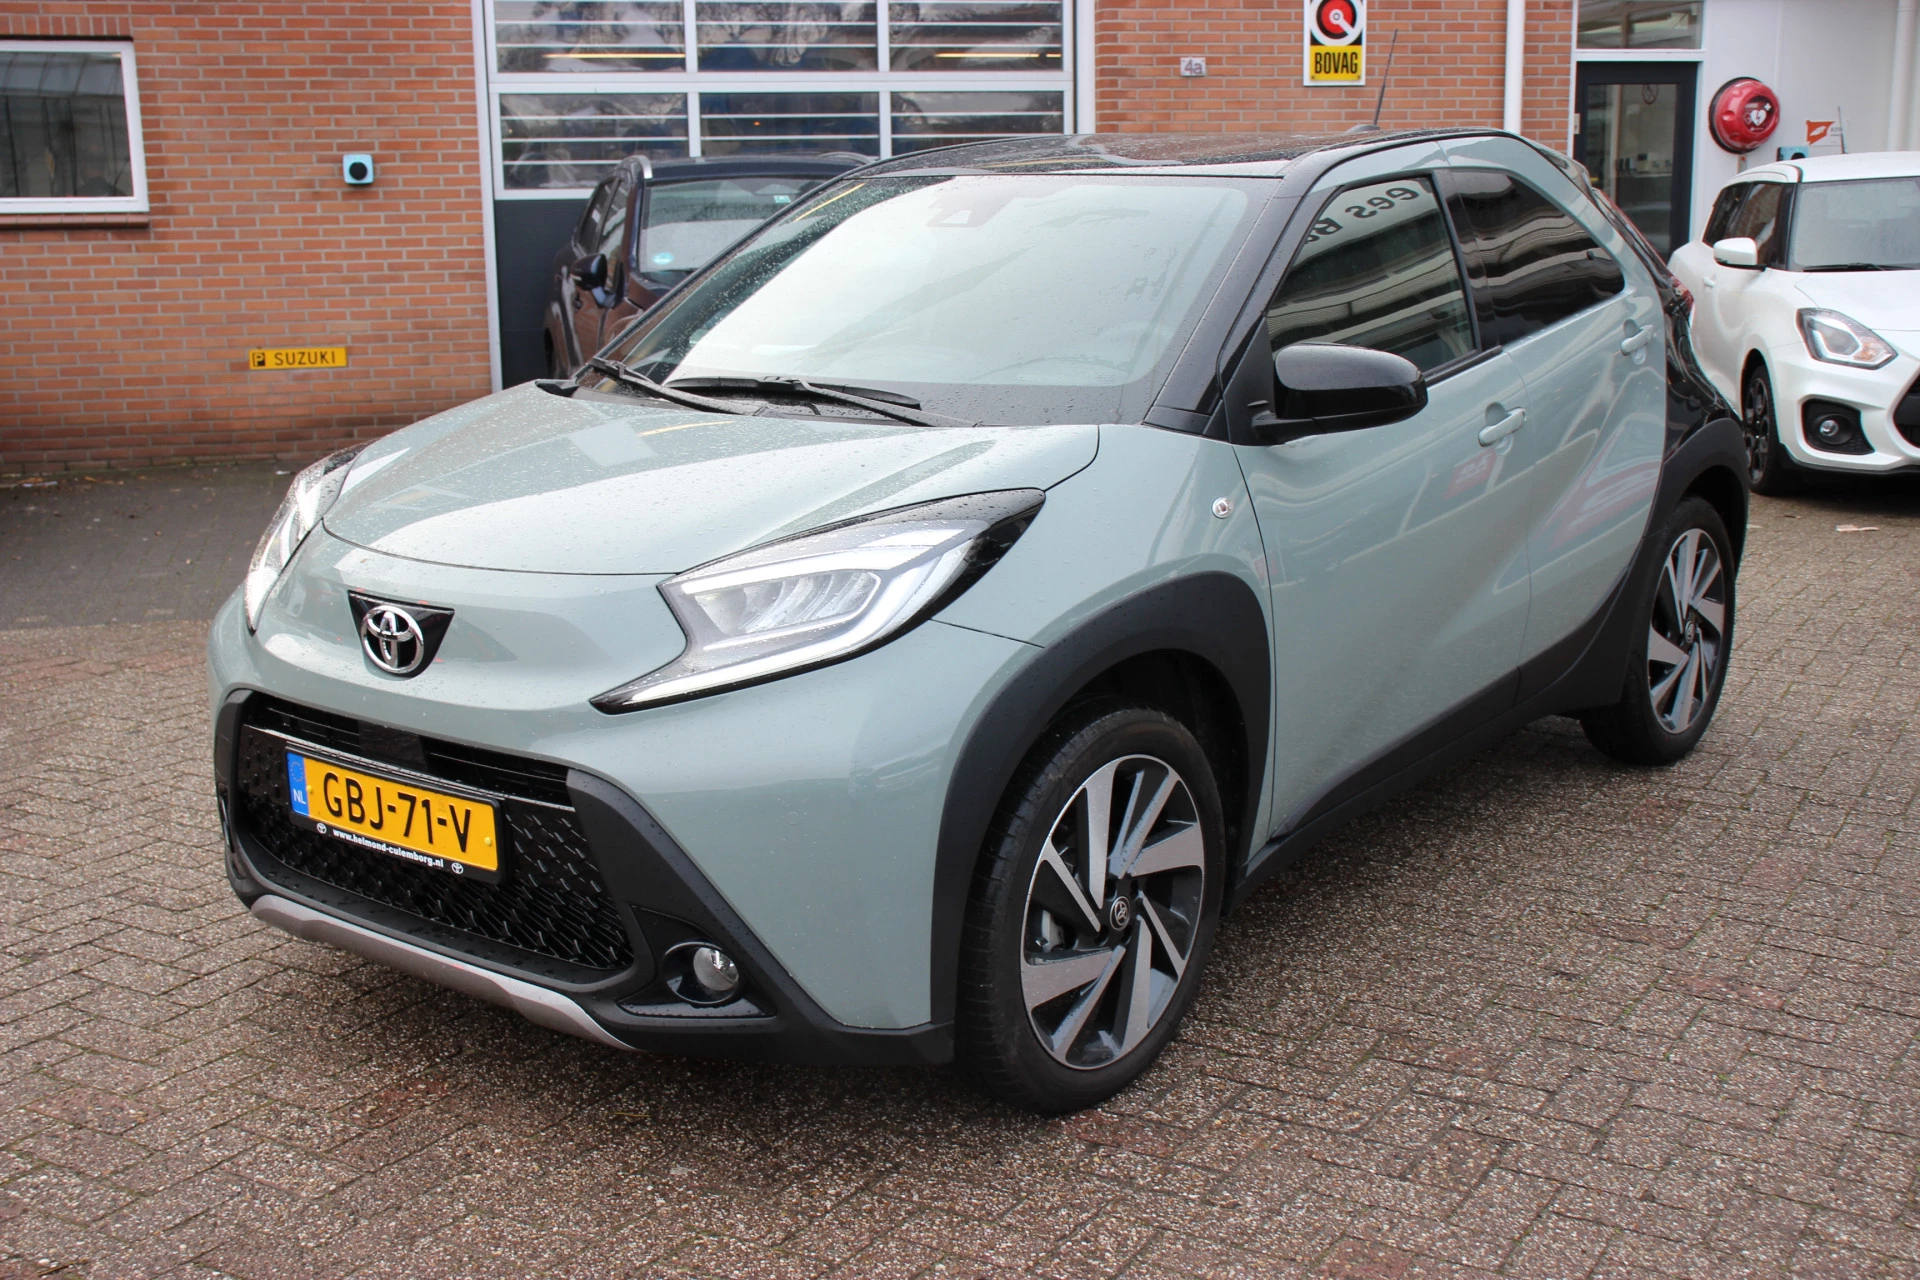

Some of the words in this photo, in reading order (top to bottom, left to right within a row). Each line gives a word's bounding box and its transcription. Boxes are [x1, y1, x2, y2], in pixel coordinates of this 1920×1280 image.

[1184, 58, 1203, 75] 4a
[1314, 51, 1359, 74] BOVAG
[274, 350, 335, 366] SUZUKI
[292, 788, 306, 805] NL
[323, 771, 472, 853] GBJ-71-V
[332, 828, 444, 868] www.helmond-culemborg.nl
